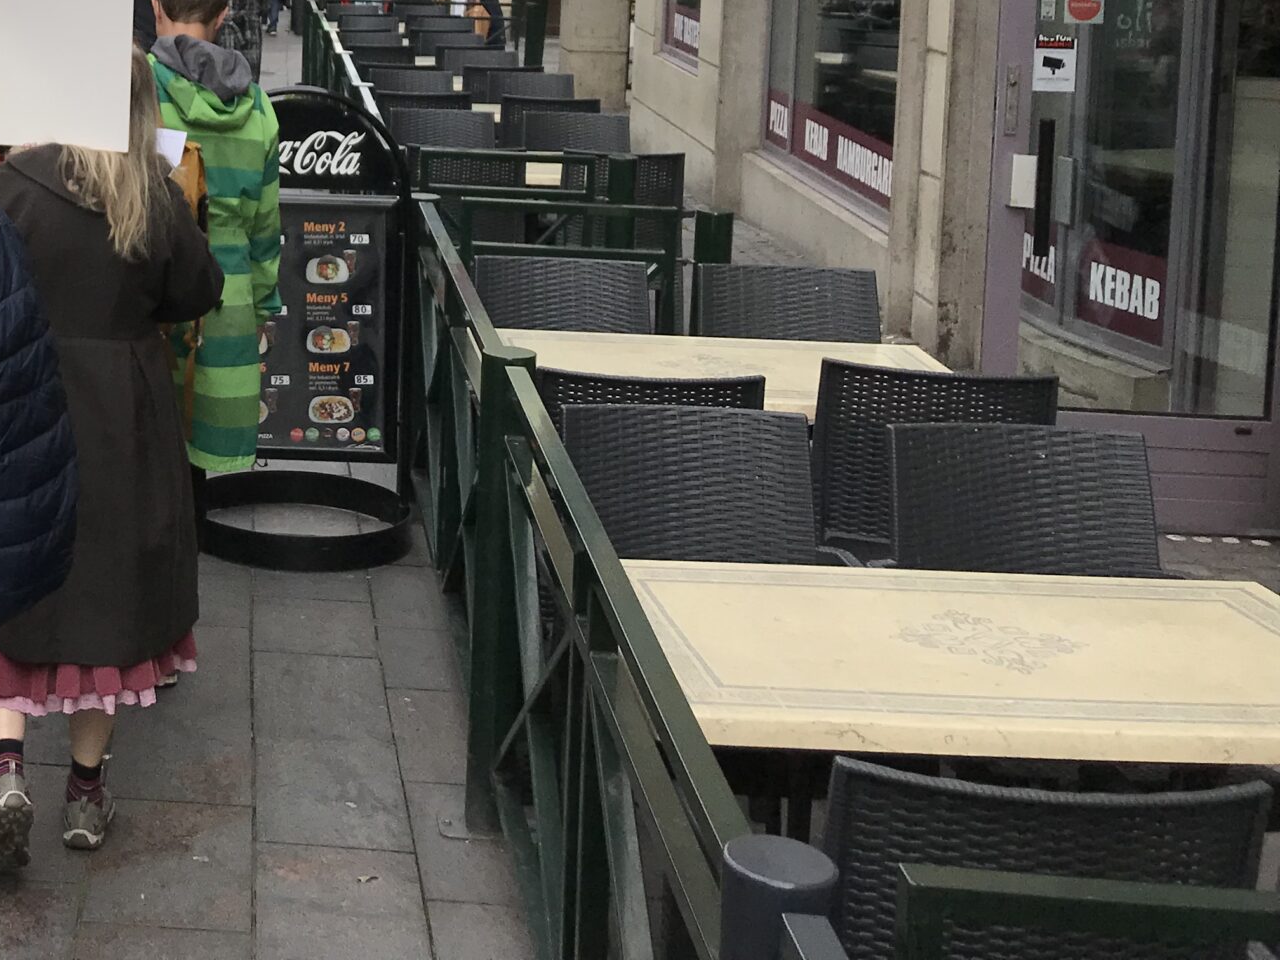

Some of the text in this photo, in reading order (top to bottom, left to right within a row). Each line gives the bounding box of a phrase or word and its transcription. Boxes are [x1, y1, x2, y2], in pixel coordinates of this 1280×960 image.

[770, 100, 788, 139] PIZZA
[805, 118, 828, 161] KEBAB
[304, 222, 345, 233] Meny 2
[1089, 261, 1160, 320] KEBAB
[306, 293, 348, 304] Meny 5
[308, 362, 340, 373] Meny
[344, 362, 350, 371] 7
